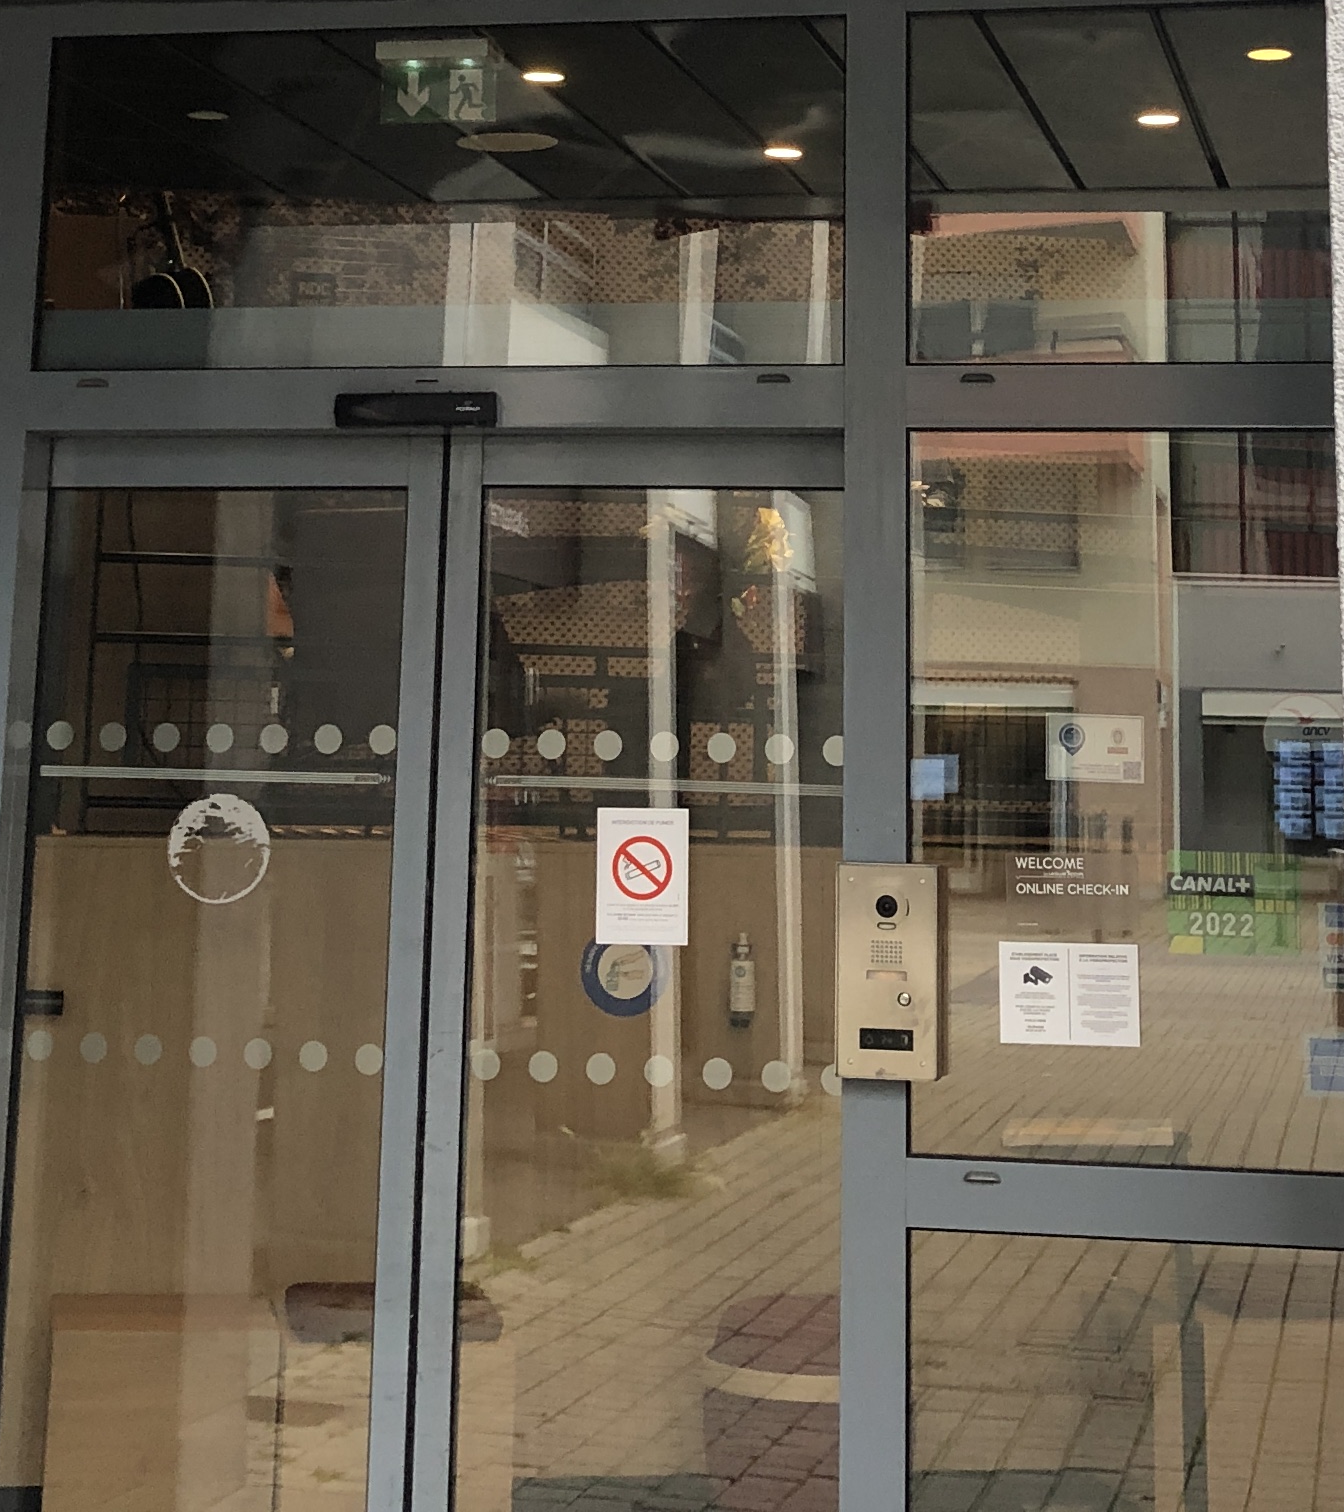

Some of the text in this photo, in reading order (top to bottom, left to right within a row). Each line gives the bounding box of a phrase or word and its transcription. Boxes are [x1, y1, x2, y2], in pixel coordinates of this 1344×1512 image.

[1015, 856, 1084, 870] WELCOME
[1016, 882, 1129, 896] ONLINE CHECK-IN
[1170, 875, 1251, 893] CANAL+
[1189, 912, 1254, 937] 2022
